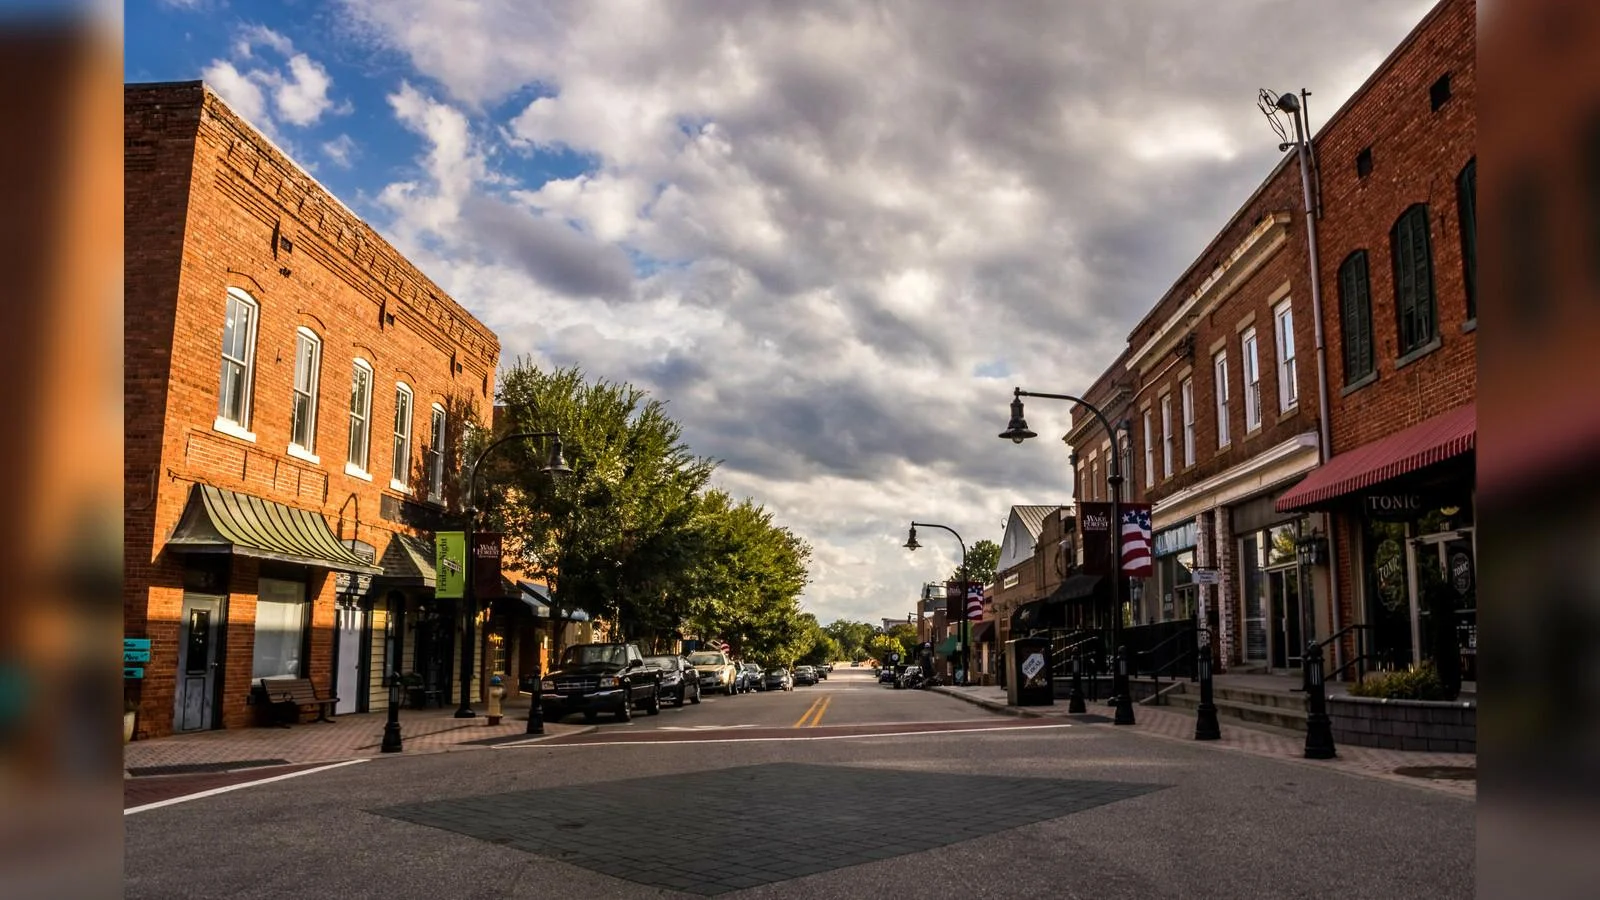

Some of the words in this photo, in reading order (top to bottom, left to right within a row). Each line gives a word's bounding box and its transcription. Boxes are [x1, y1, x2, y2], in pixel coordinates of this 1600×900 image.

[1368, 494, 1420, 510] TONIC
[438, 538, 449, 560] Night
[438, 564, 447, 592] Friday
[1378, 555, 1400, 582] TONIC
[1453, 562, 1470, 576] TONIC
